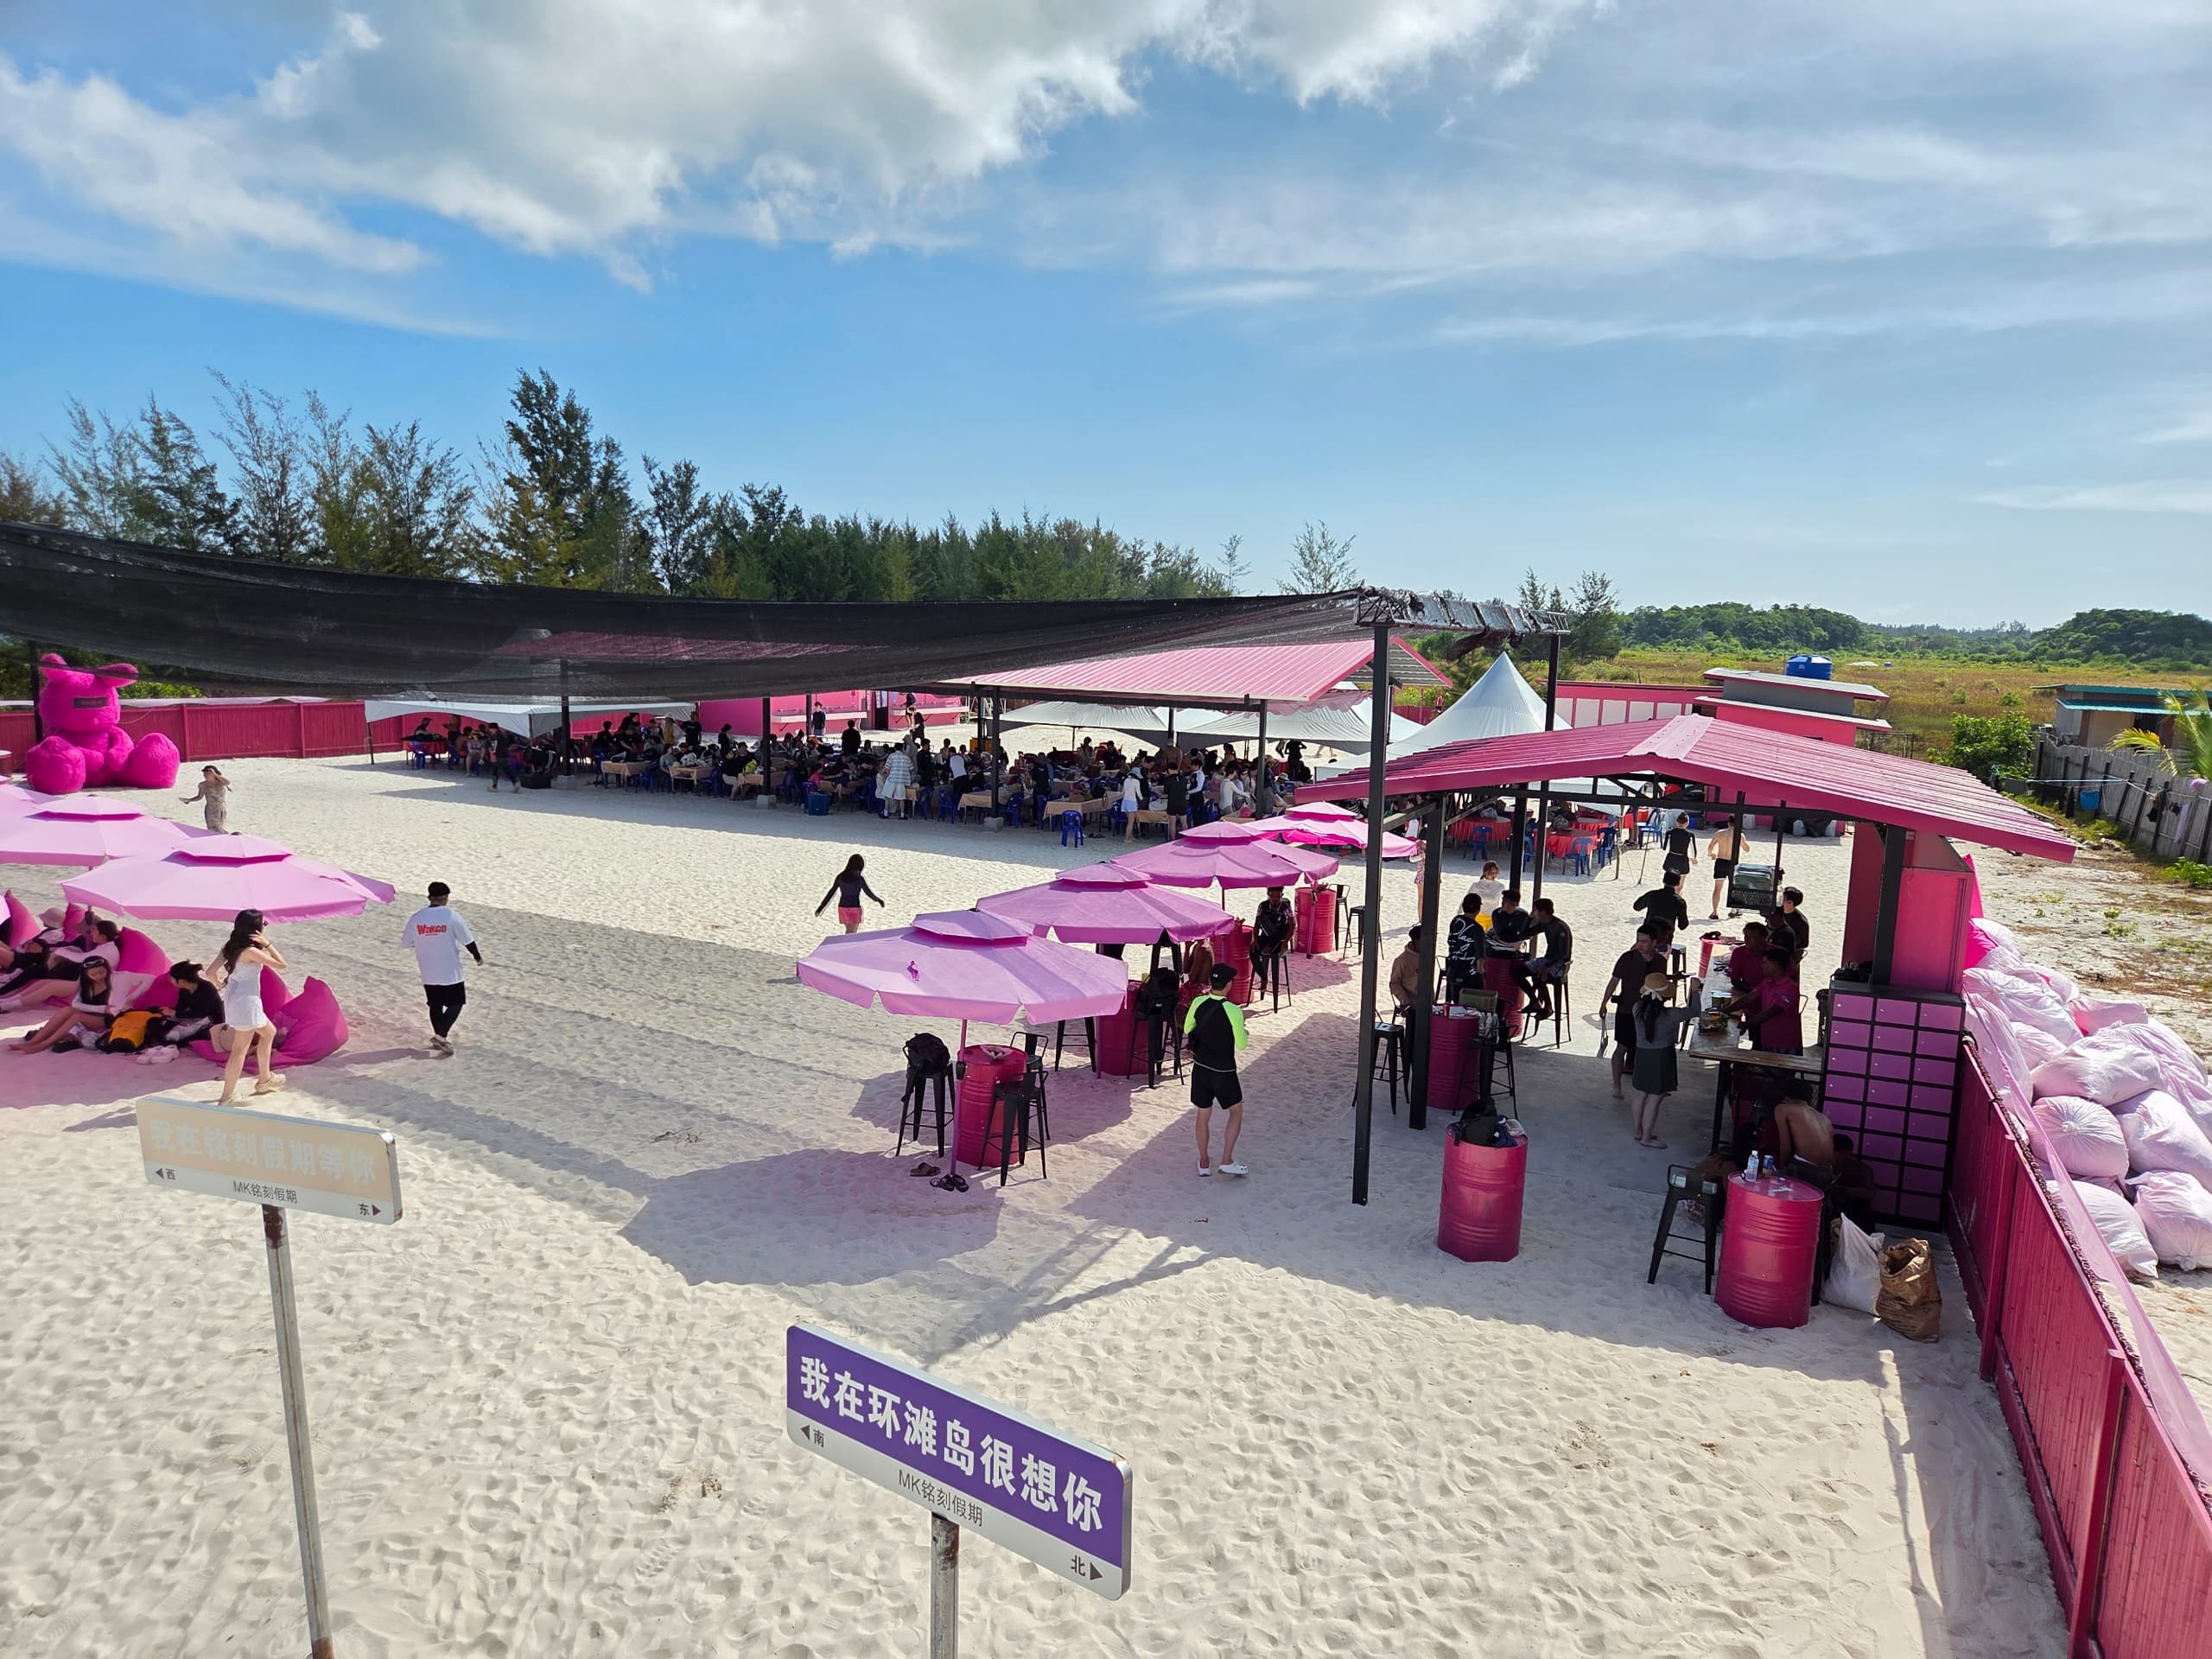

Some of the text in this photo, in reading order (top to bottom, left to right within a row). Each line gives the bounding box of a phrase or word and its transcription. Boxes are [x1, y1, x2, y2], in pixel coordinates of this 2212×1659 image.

[165, 1168, 176, 1180] 西
[232, 1180, 298, 1204] MK铭刻假期
[359, 1203, 371, 1217] 东
[800, 1357, 1103, 1533] 我在环滩岛很想你
[813, 1429, 825, 1448] 南
[899, 1470, 983, 1528] MK铭刻假期
[1071, 1554, 1086, 1577] 北
